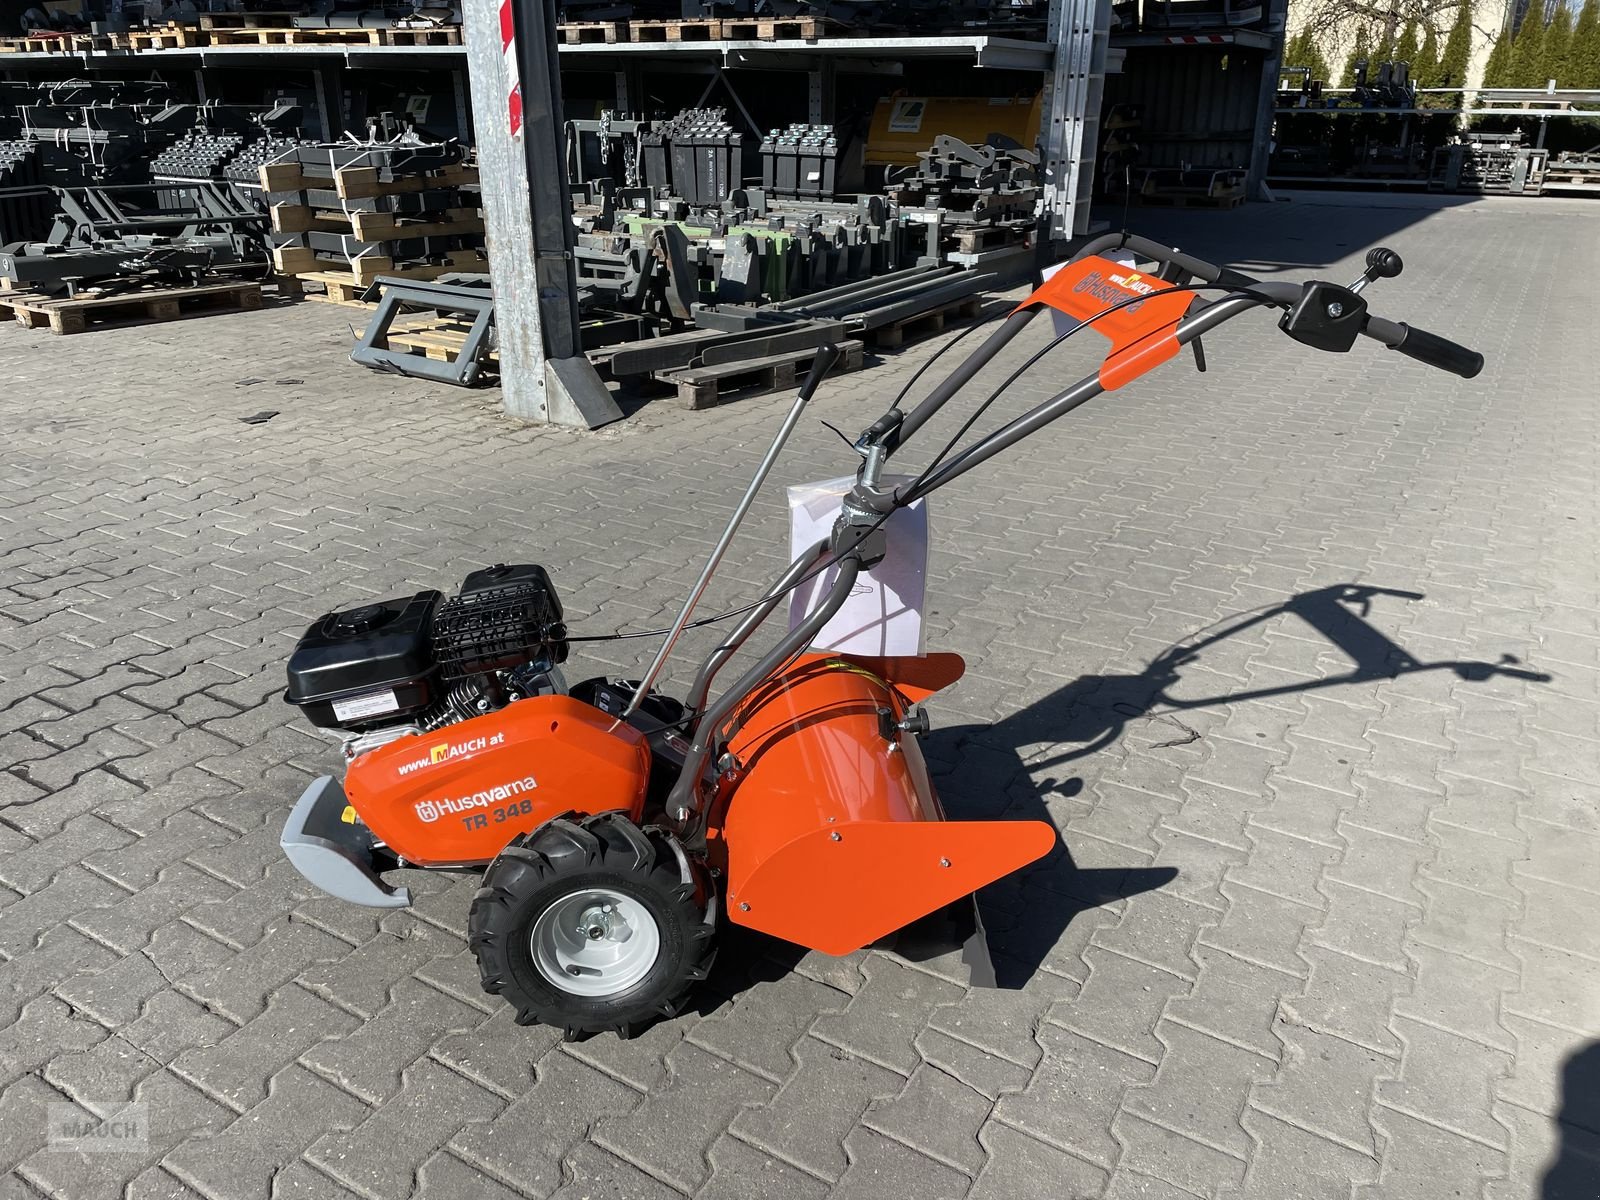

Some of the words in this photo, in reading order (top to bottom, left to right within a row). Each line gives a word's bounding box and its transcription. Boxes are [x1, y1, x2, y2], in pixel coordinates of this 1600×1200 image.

[1087, 277, 1145, 315] Husqvaa
[489, 732, 505, 746] at
[436, 776, 538, 816] Husqvarna
[462, 813, 488, 832] TR
[493, 799, 533, 824] 348
